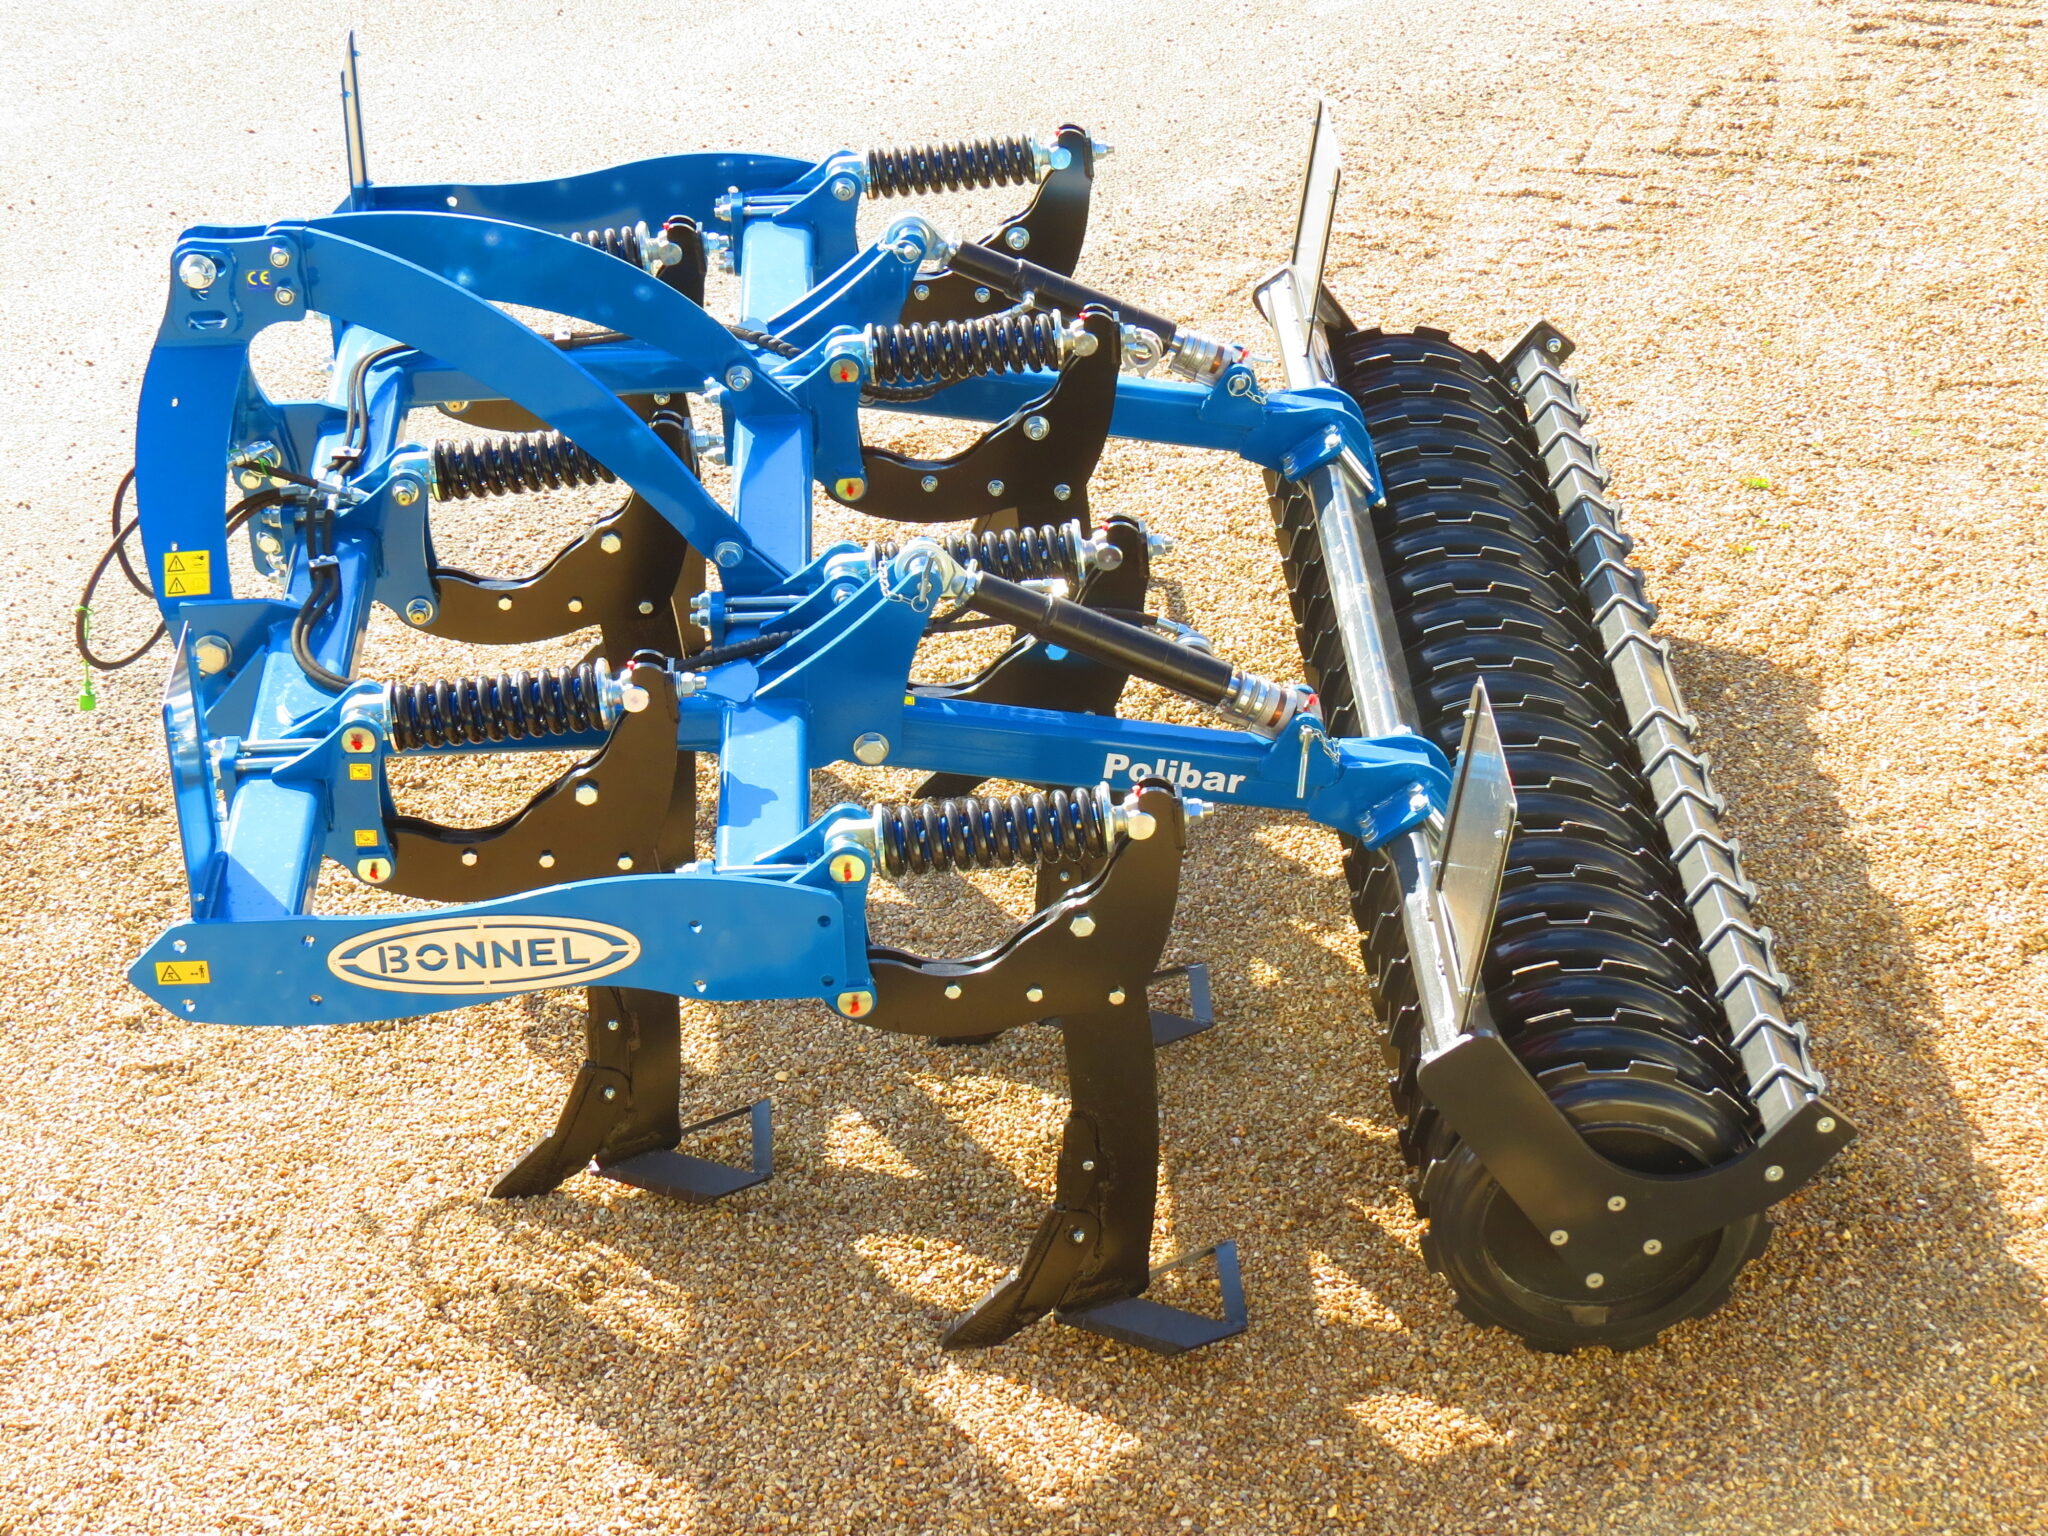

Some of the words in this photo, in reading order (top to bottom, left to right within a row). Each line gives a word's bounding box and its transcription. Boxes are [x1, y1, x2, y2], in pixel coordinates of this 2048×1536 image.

[247, 270, 271, 286] CE
[1102, 752, 1247, 794] Polibar
[377, 936, 591, 974] BONNEL
